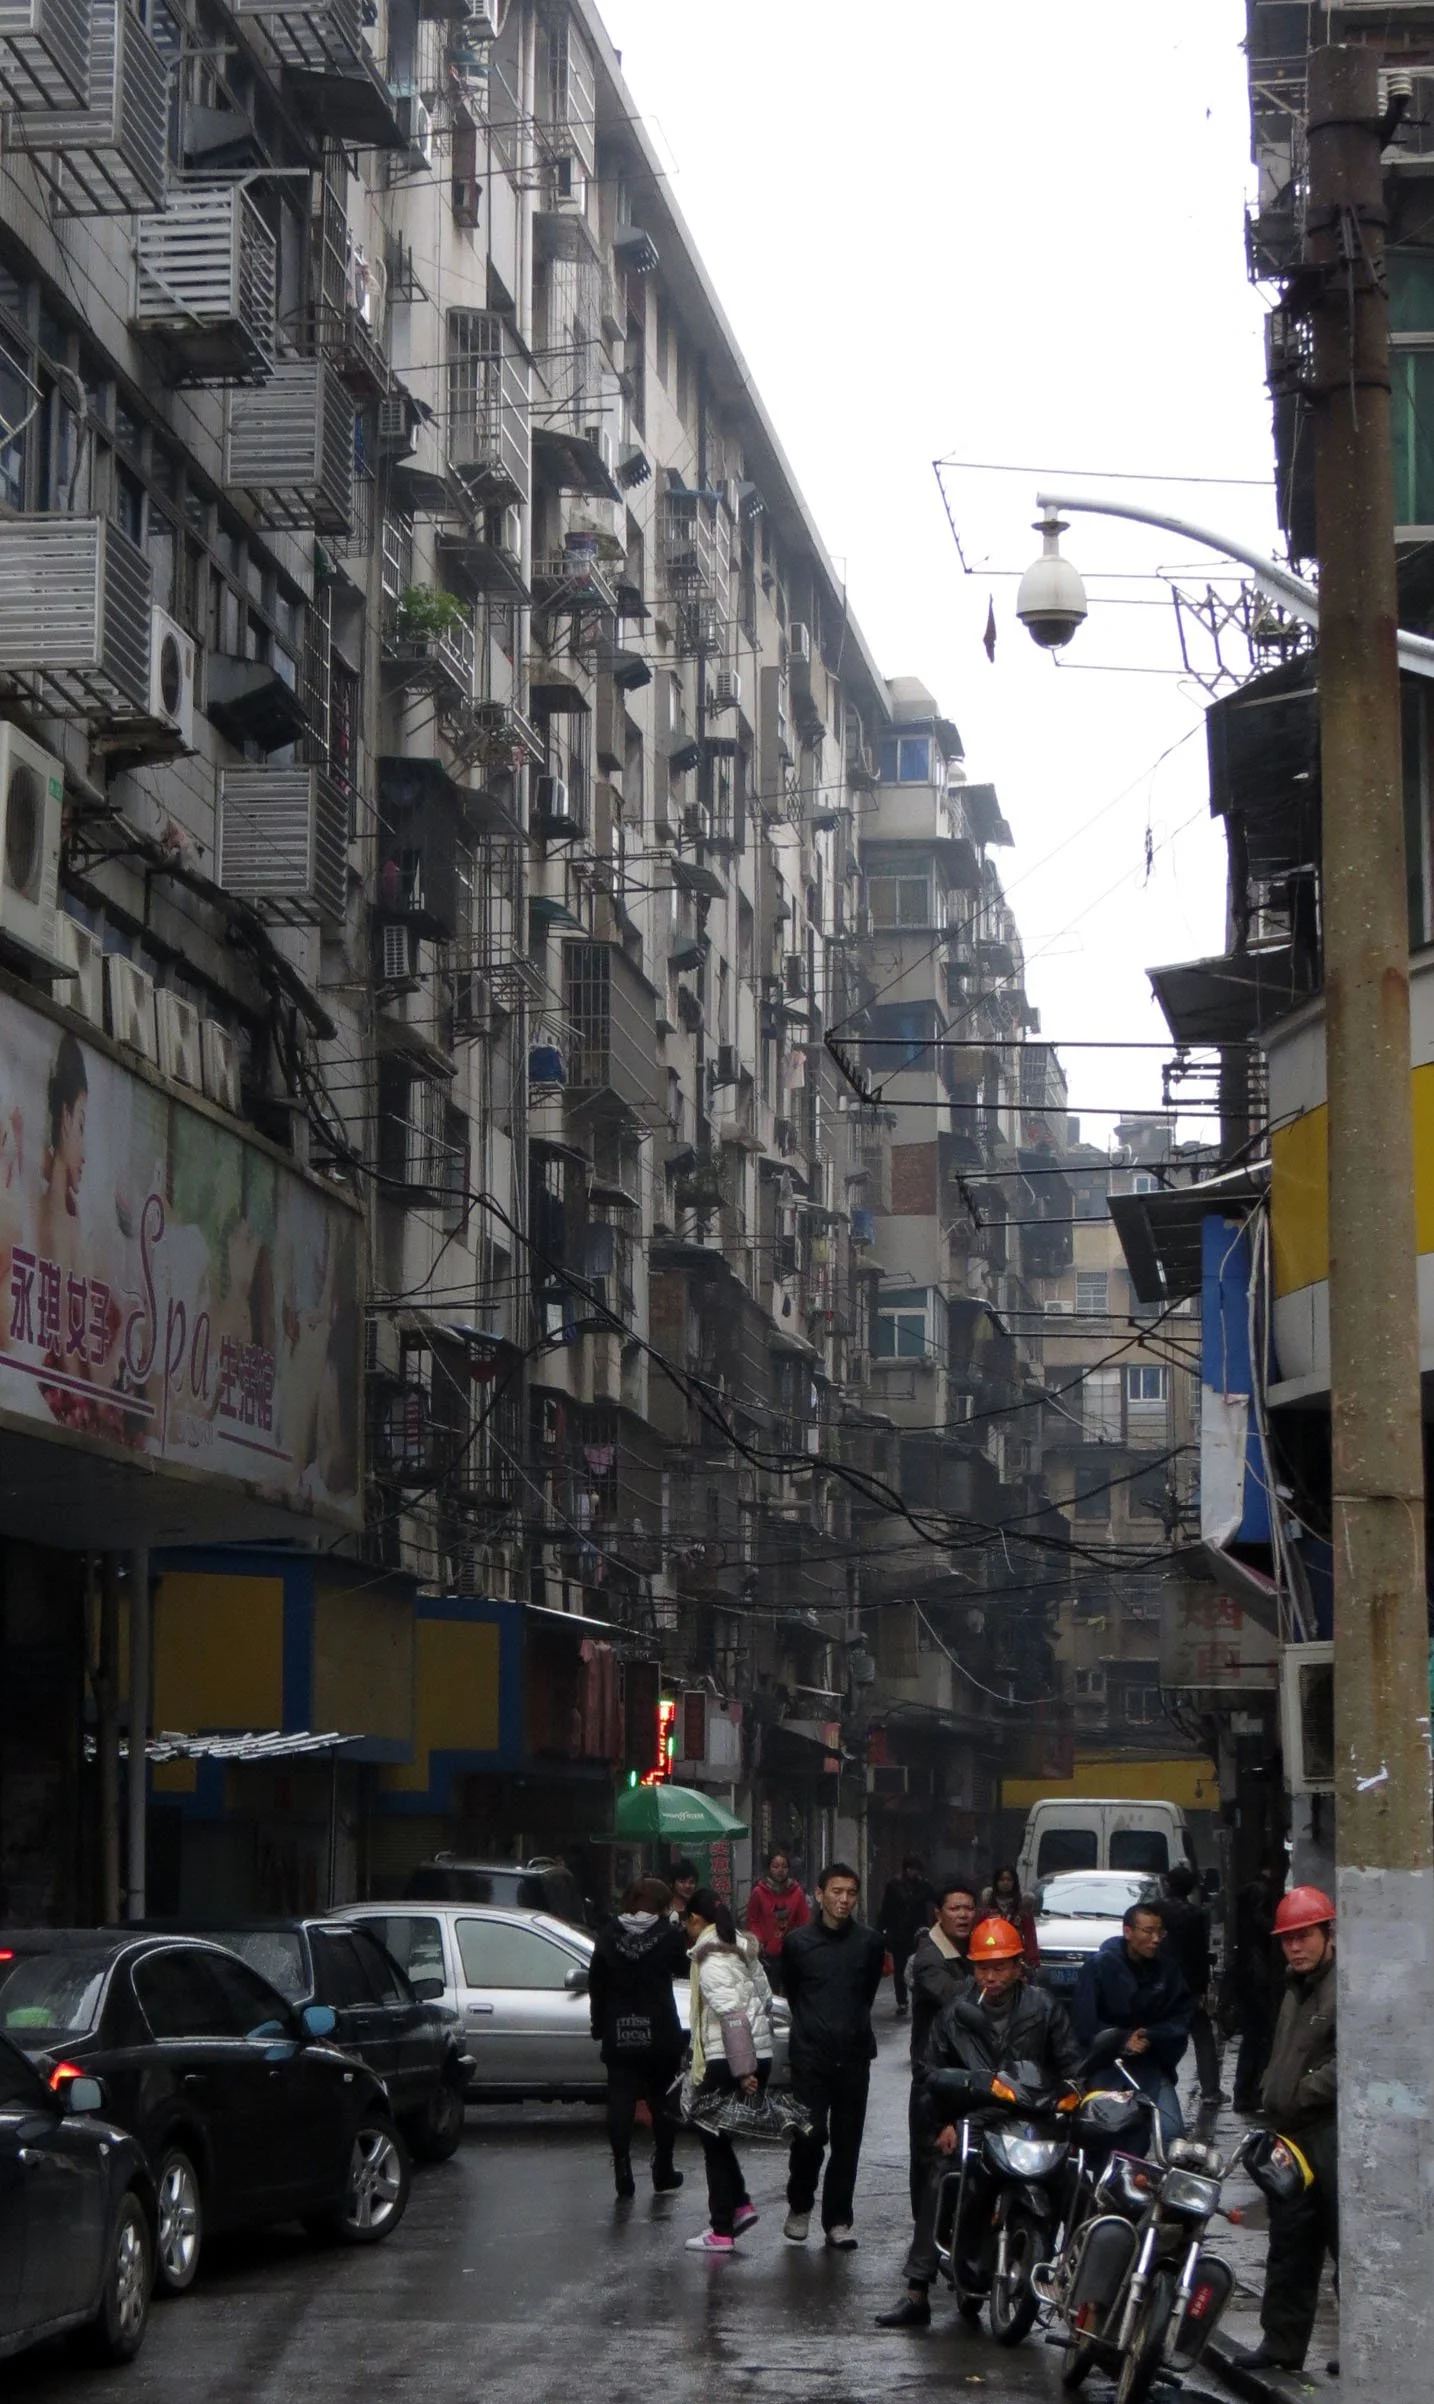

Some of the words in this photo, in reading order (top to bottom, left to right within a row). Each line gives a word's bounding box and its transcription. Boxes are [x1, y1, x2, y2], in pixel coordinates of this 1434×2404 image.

[10, 1246, 110, 1366] 永琪女子
[122, 1194, 211, 1454] Spa
[616, 2013, 650, 2027] miss
[616, 2027, 652, 2041] local
